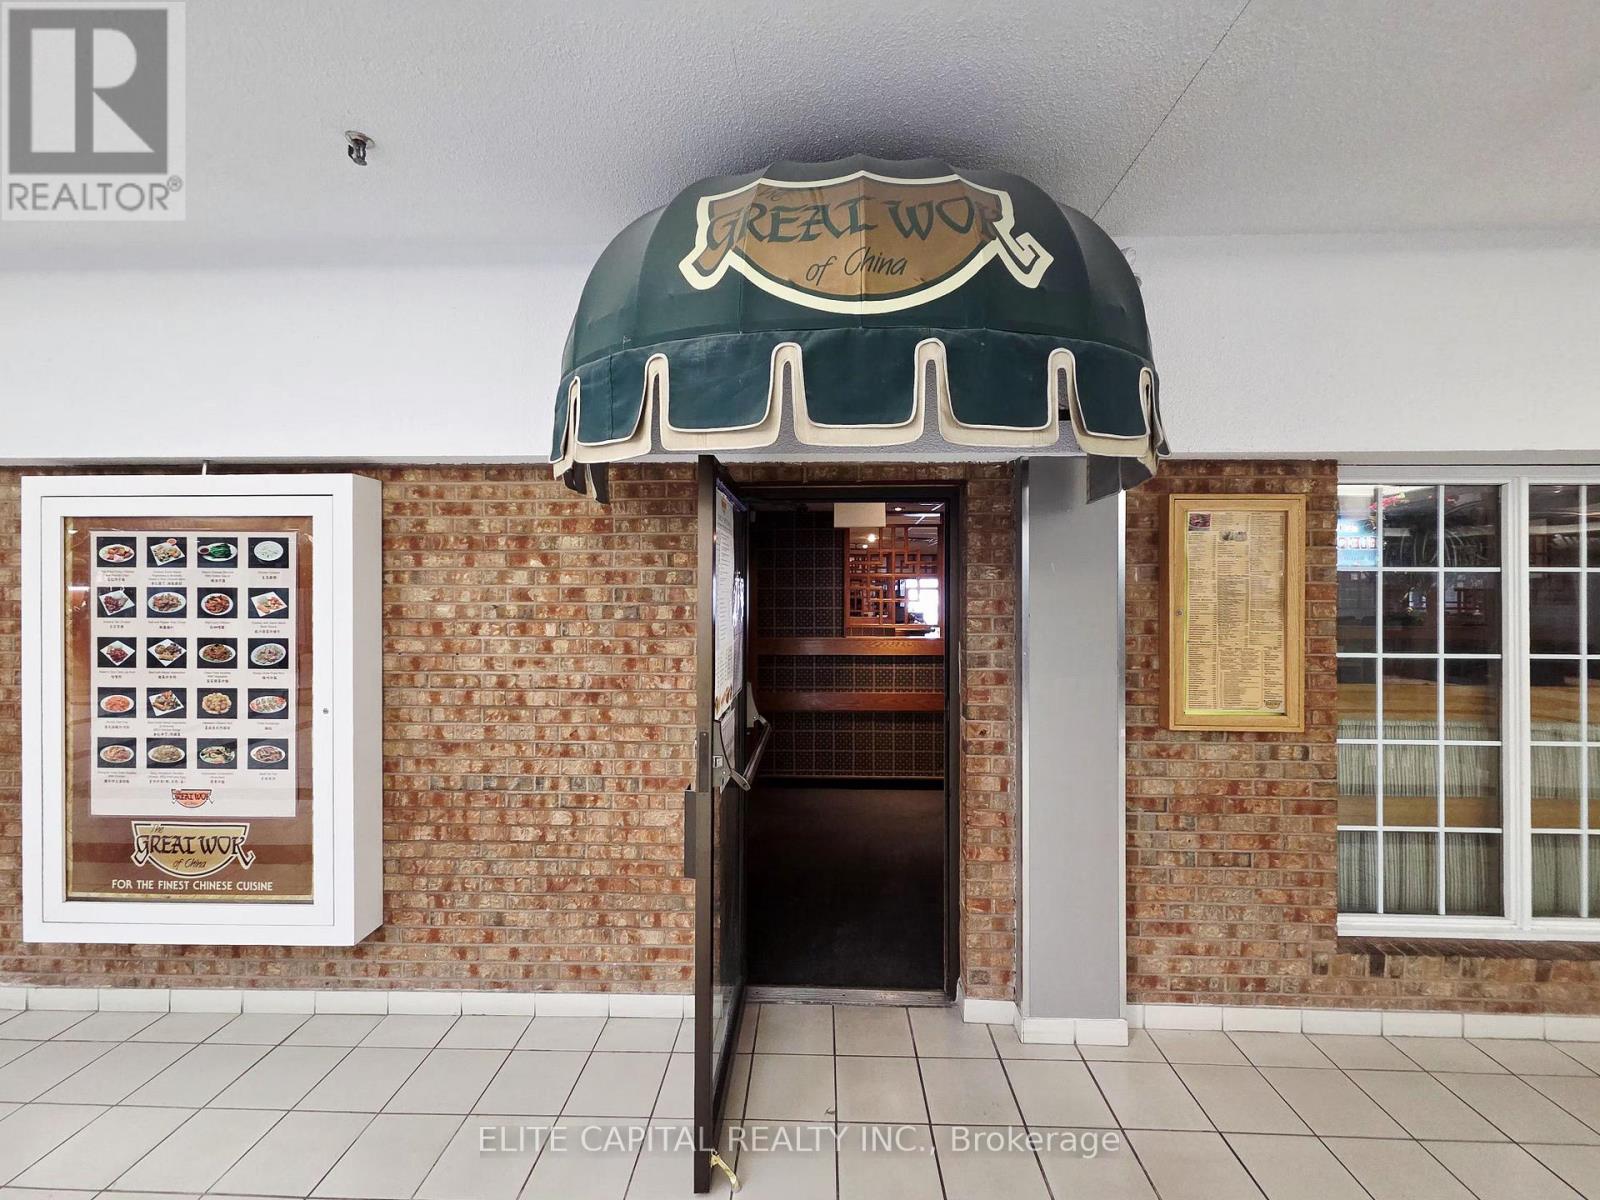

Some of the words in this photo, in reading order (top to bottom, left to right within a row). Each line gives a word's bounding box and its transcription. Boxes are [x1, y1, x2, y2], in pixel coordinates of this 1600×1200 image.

[694, 195, 877, 270] GREAT
[806, 256, 838, 286] of
[844, 246, 909, 277] China
[150, 824, 164, 833] The
[135, 835, 195, 862] GREAT
[200, 836, 251, 863] WOK
[173, 859, 183, 870] of
[185, 858, 207, 868] China
[111, 879, 133, 889] FOR
[136, 880, 154, 890] THE
[158, 880, 190, 890] FINEST
[192, 881, 233, 890] CHINESE
[236, 881, 273, 891] CUISINE
